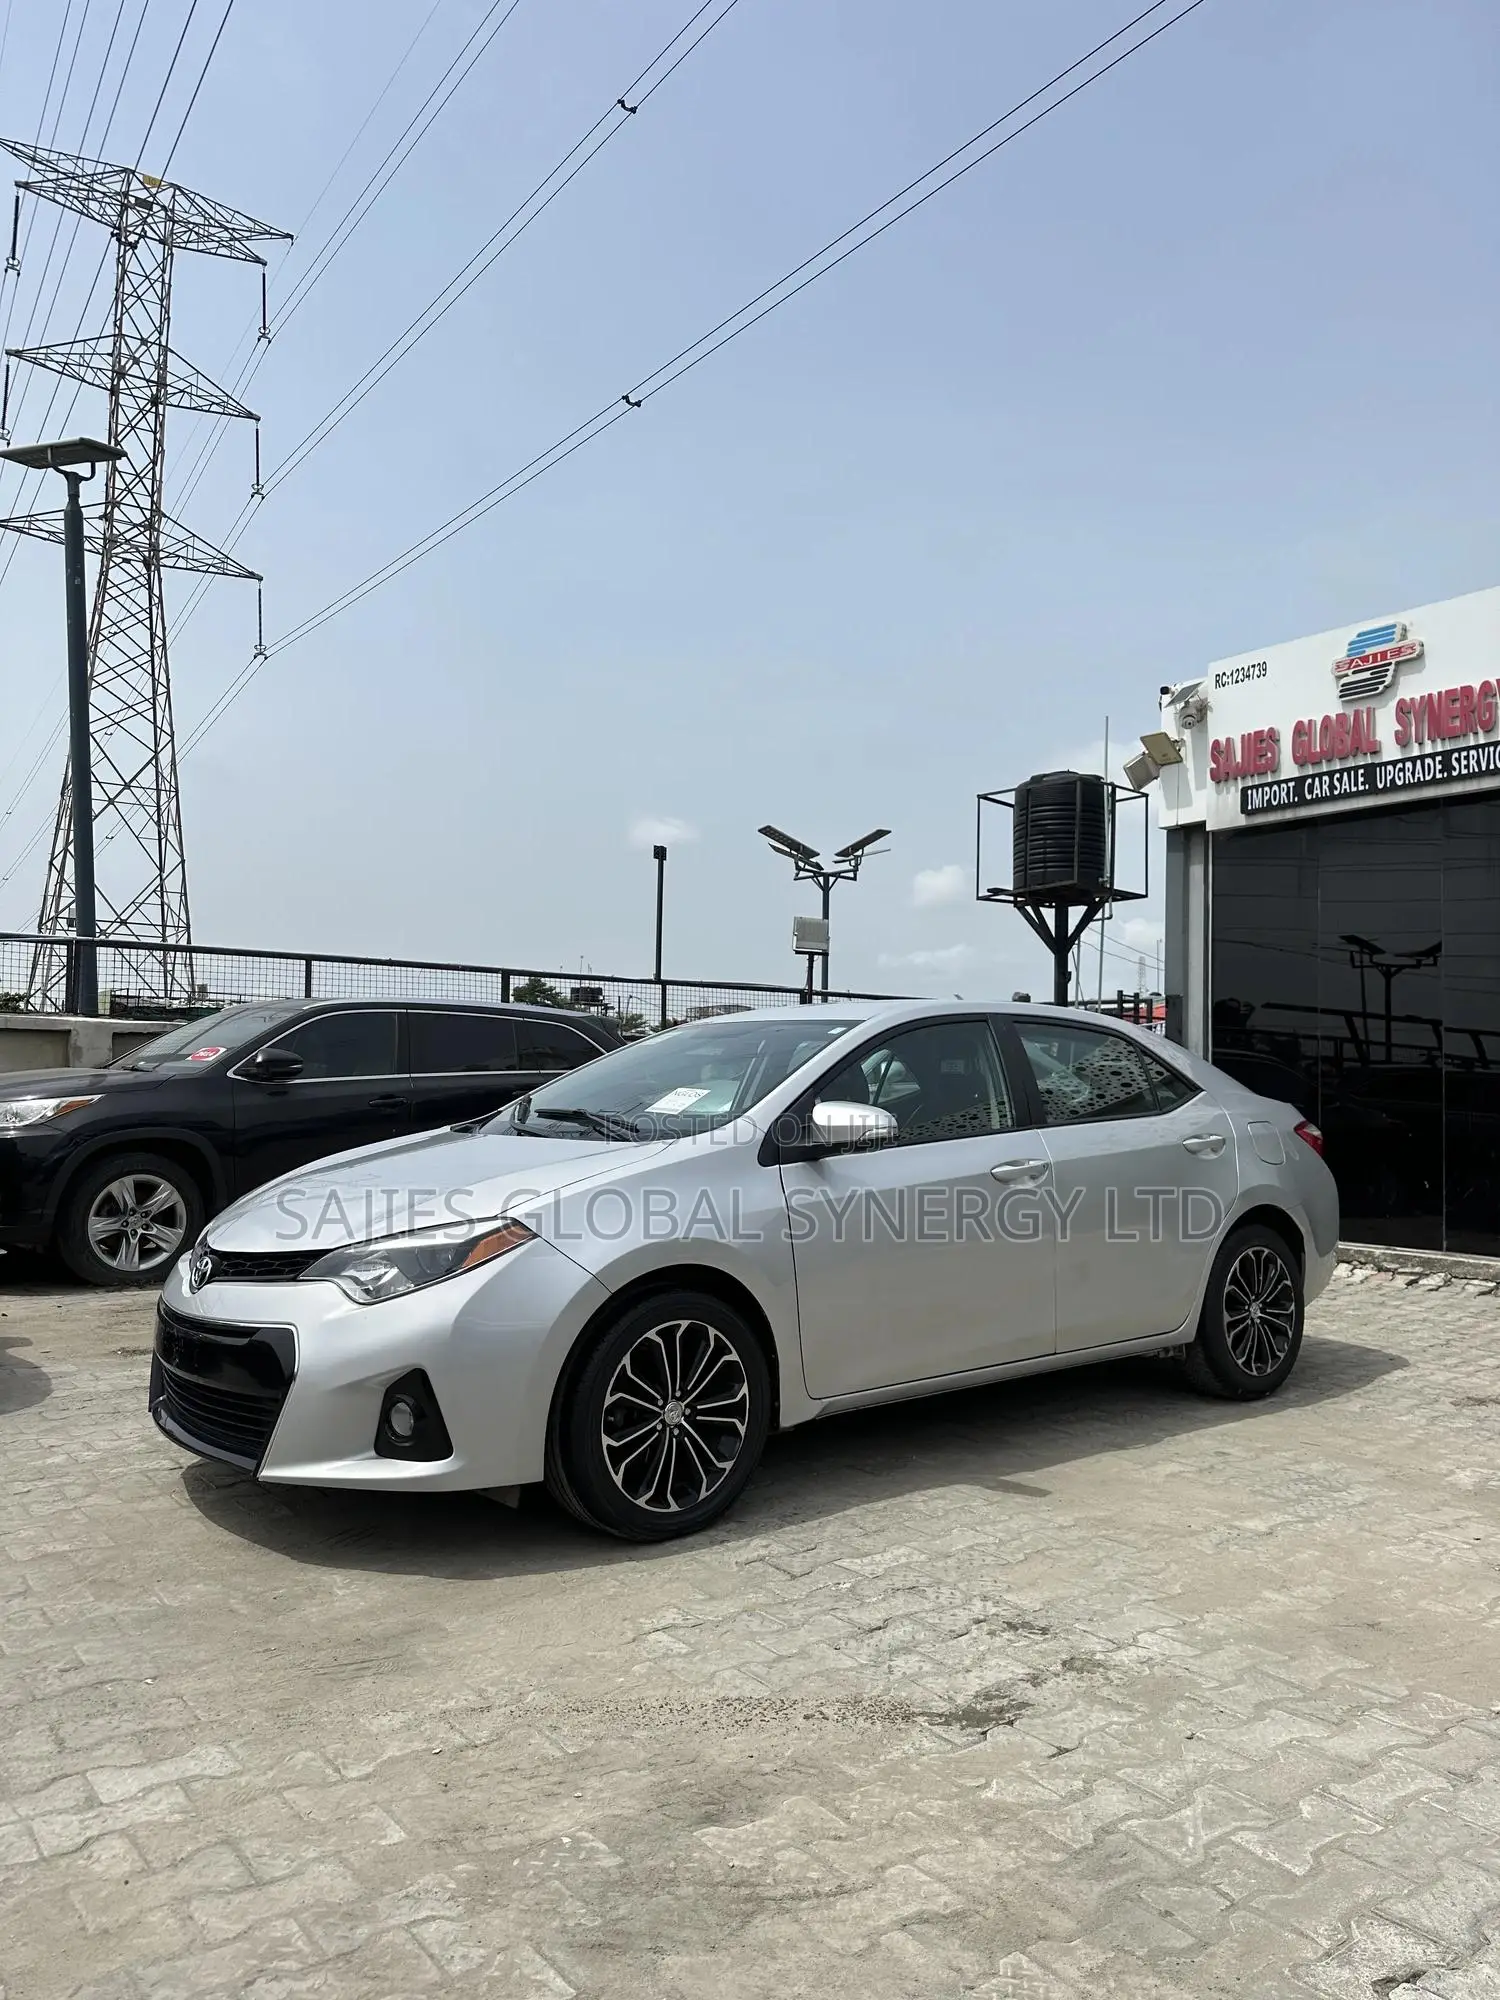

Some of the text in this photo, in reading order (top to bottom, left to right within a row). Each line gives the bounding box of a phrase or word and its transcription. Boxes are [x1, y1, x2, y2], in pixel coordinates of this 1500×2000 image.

[1215, 661, 1267, 689] RC:1234739
[1335, 642, 1417, 673] SAJIES
[1210, 727, 1279, 783] SAJIES
[1292, 707, 1380, 766] GLOBAL
[1247, 781, 1298, 810] IMPORT.
[1304, 772, 1330, 800] CAR
[1333, 768, 1369, 796] SALE.
[1376, 756, 1447, 789] UPGRADE.
